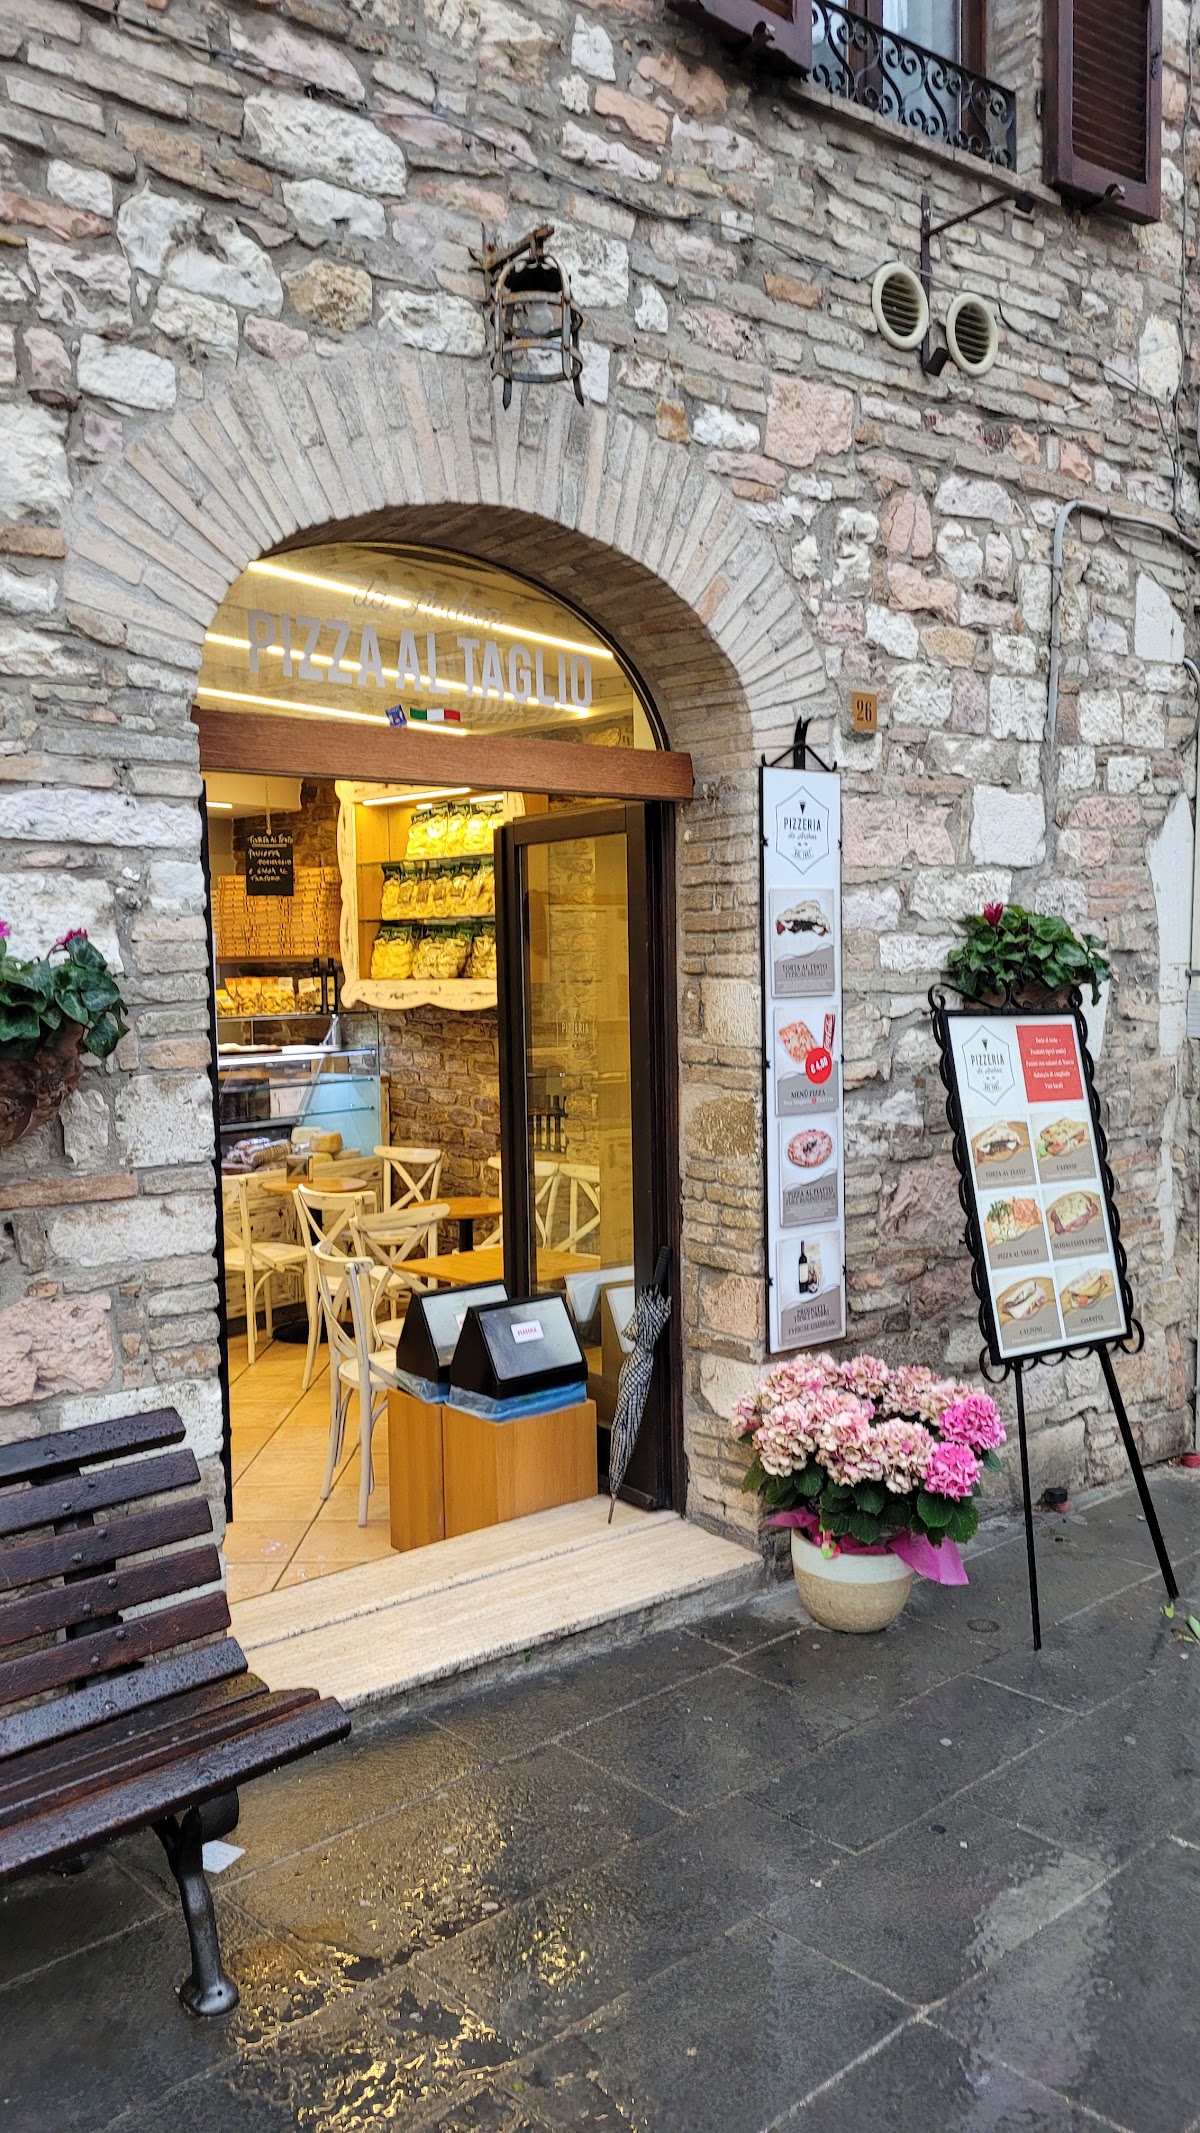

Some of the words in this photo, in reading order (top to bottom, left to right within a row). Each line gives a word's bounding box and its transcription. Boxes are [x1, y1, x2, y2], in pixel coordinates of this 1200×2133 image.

[353, 576, 391, 611] da
[246, 607, 386, 689] PIZZA
[395, 629, 449, 695] AL
[456, 636, 593, 708] TAGLIO
[857, 699, 872, 722] 26
[783, 817, 822, 832] PIZZERIA
[562, 1022, 589, 1034] PIZZERIA
[970, 1054, 1005, 1067] PIZZERIA
[809, 1088, 826, 1097] PIZZA
[985, 1170, 1002, 1178] TORTA
[997, 1252, 1013, 1260] PIZZA
[1020, 1248, 1040, 1257] TAGLIO
